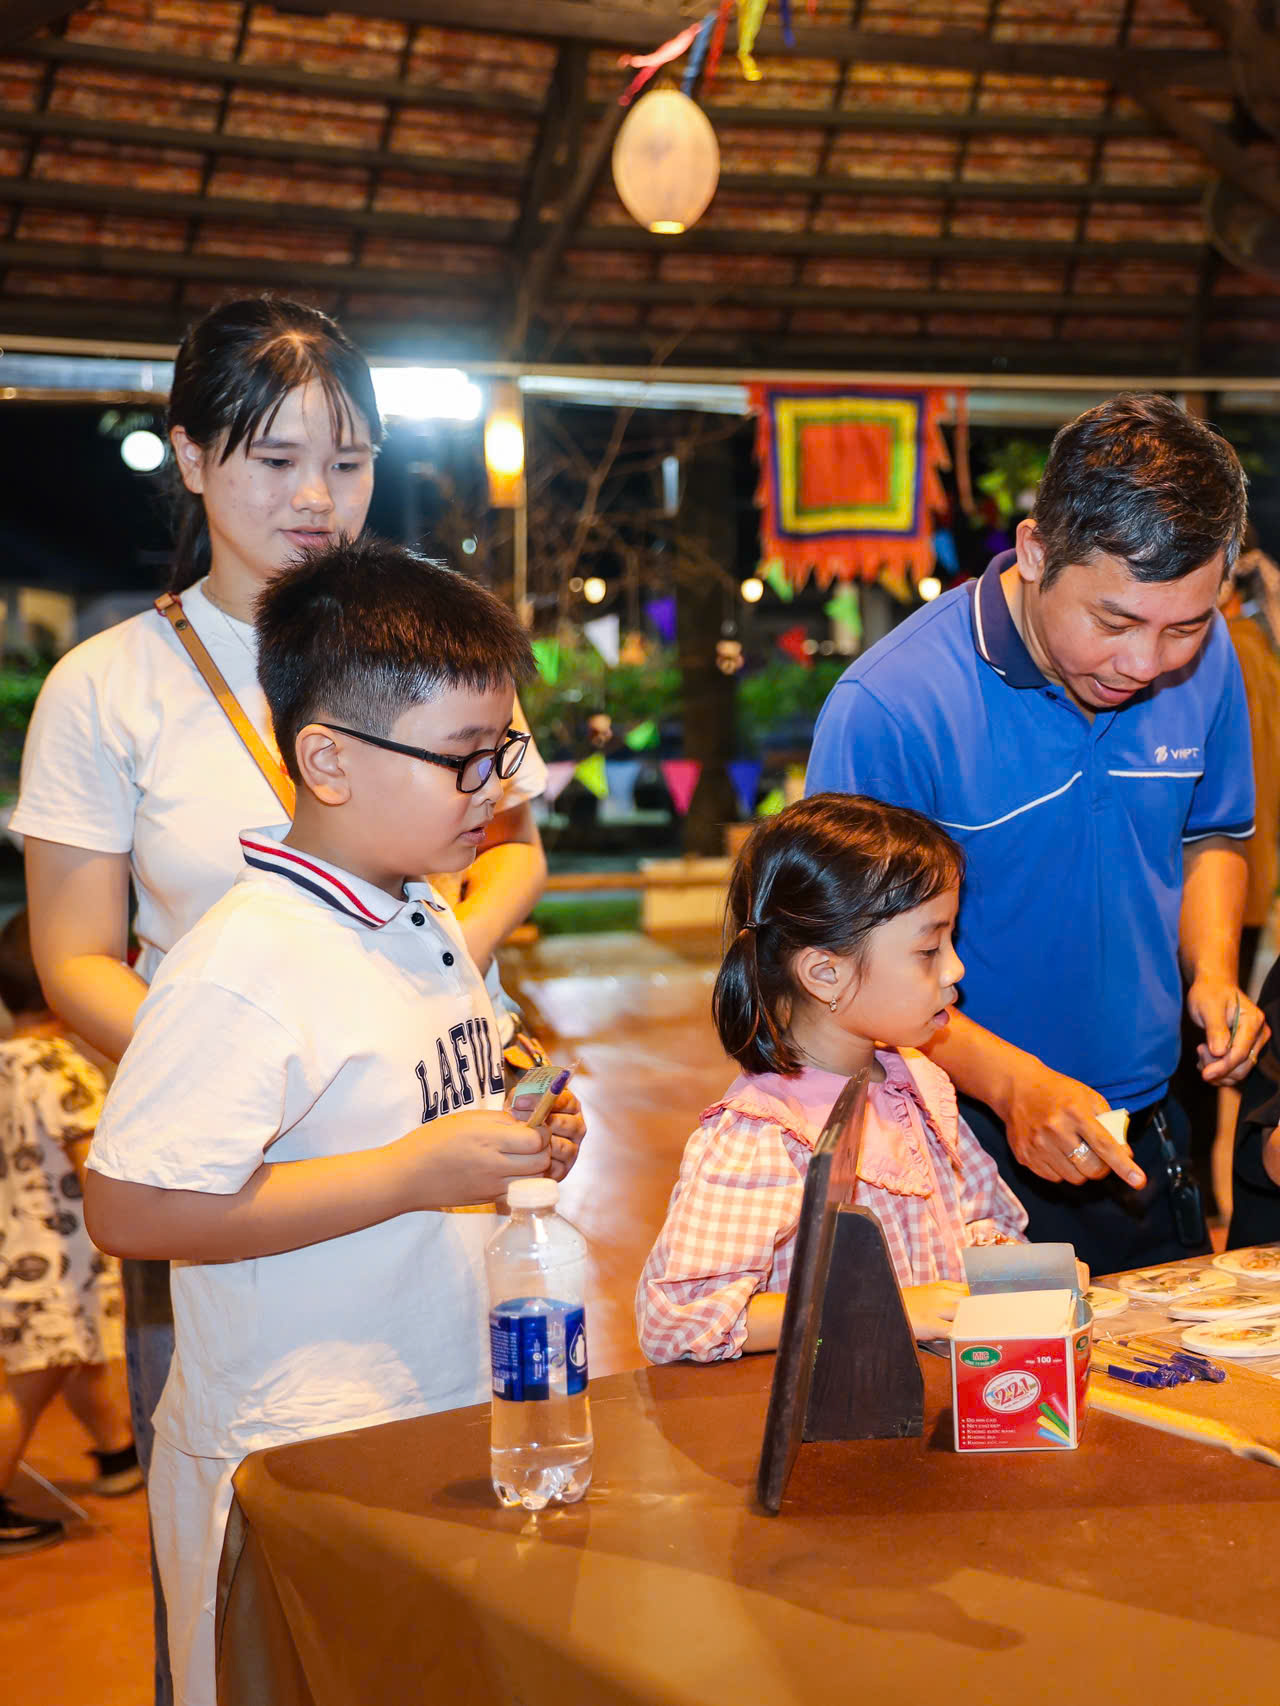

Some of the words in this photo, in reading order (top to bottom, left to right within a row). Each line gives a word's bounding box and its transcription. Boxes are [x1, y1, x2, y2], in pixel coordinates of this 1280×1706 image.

[415, 1017, 505, 1124] LAFVL
[1036, 1356, 1052, 1364] 100
[994, 1377, 1031, 1406] 221
